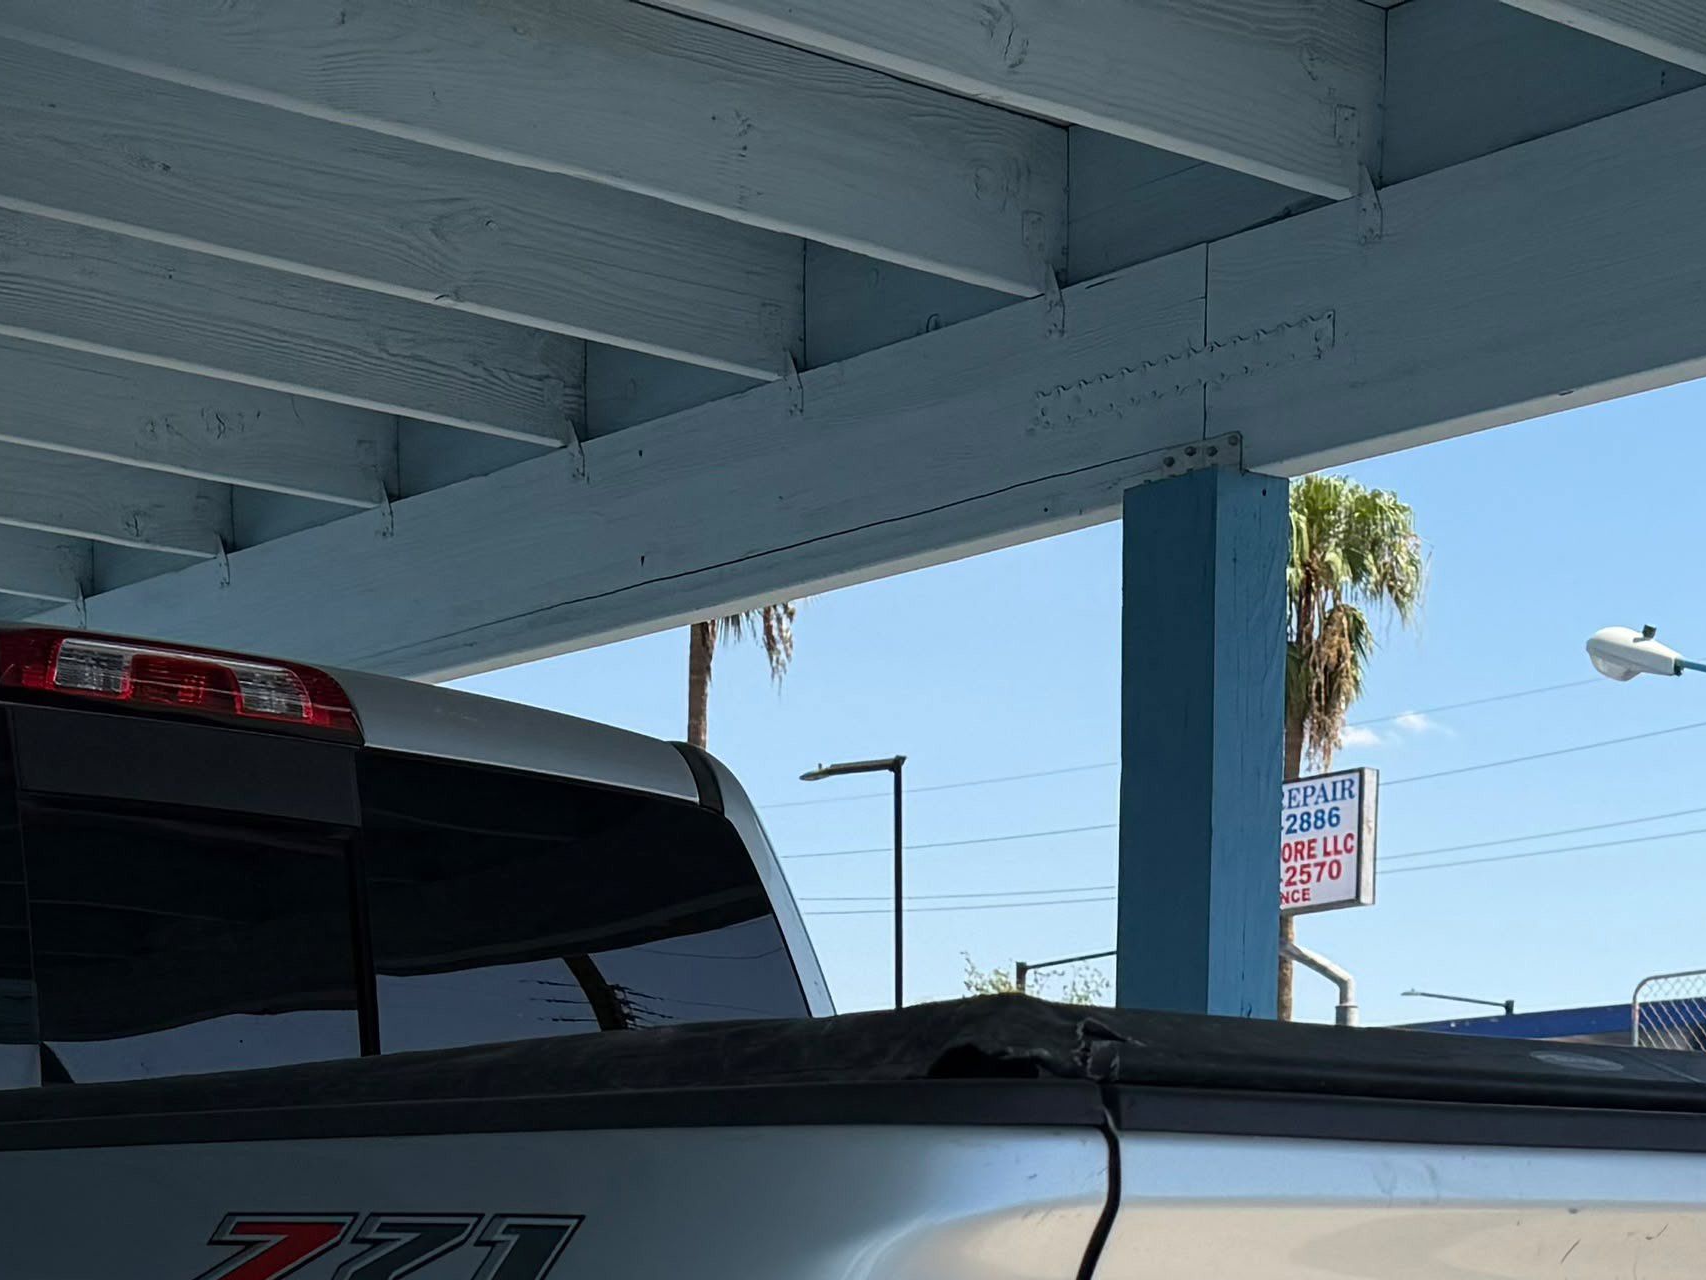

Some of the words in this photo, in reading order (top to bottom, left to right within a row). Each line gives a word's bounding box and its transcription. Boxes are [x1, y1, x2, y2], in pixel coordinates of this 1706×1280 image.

[1282, 778, 1355, 809] EPAIR
[1281, 838, 1317, 863] ORE
[1323, 832, 1355, 858] LLC
